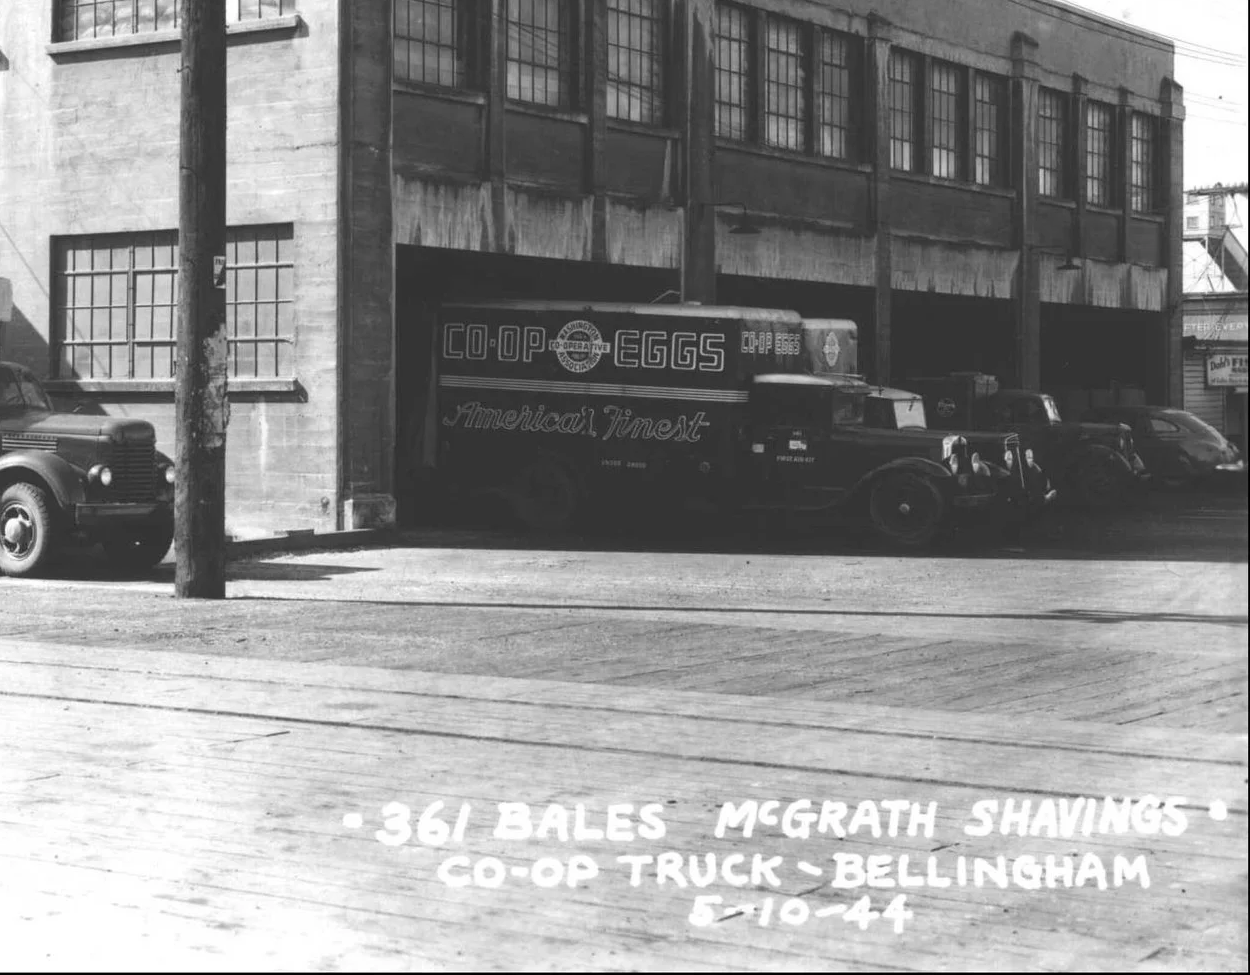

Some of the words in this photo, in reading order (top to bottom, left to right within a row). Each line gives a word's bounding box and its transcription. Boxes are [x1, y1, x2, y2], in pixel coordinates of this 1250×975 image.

[550, 341, 609, 352] CO-OPERATIVE
[614, 330, 725, 371] EGGS
[775, 332, 800, 355] EGGS
[442, 400, 597, 438] America's
[603, 404, 711, 442] Finest
